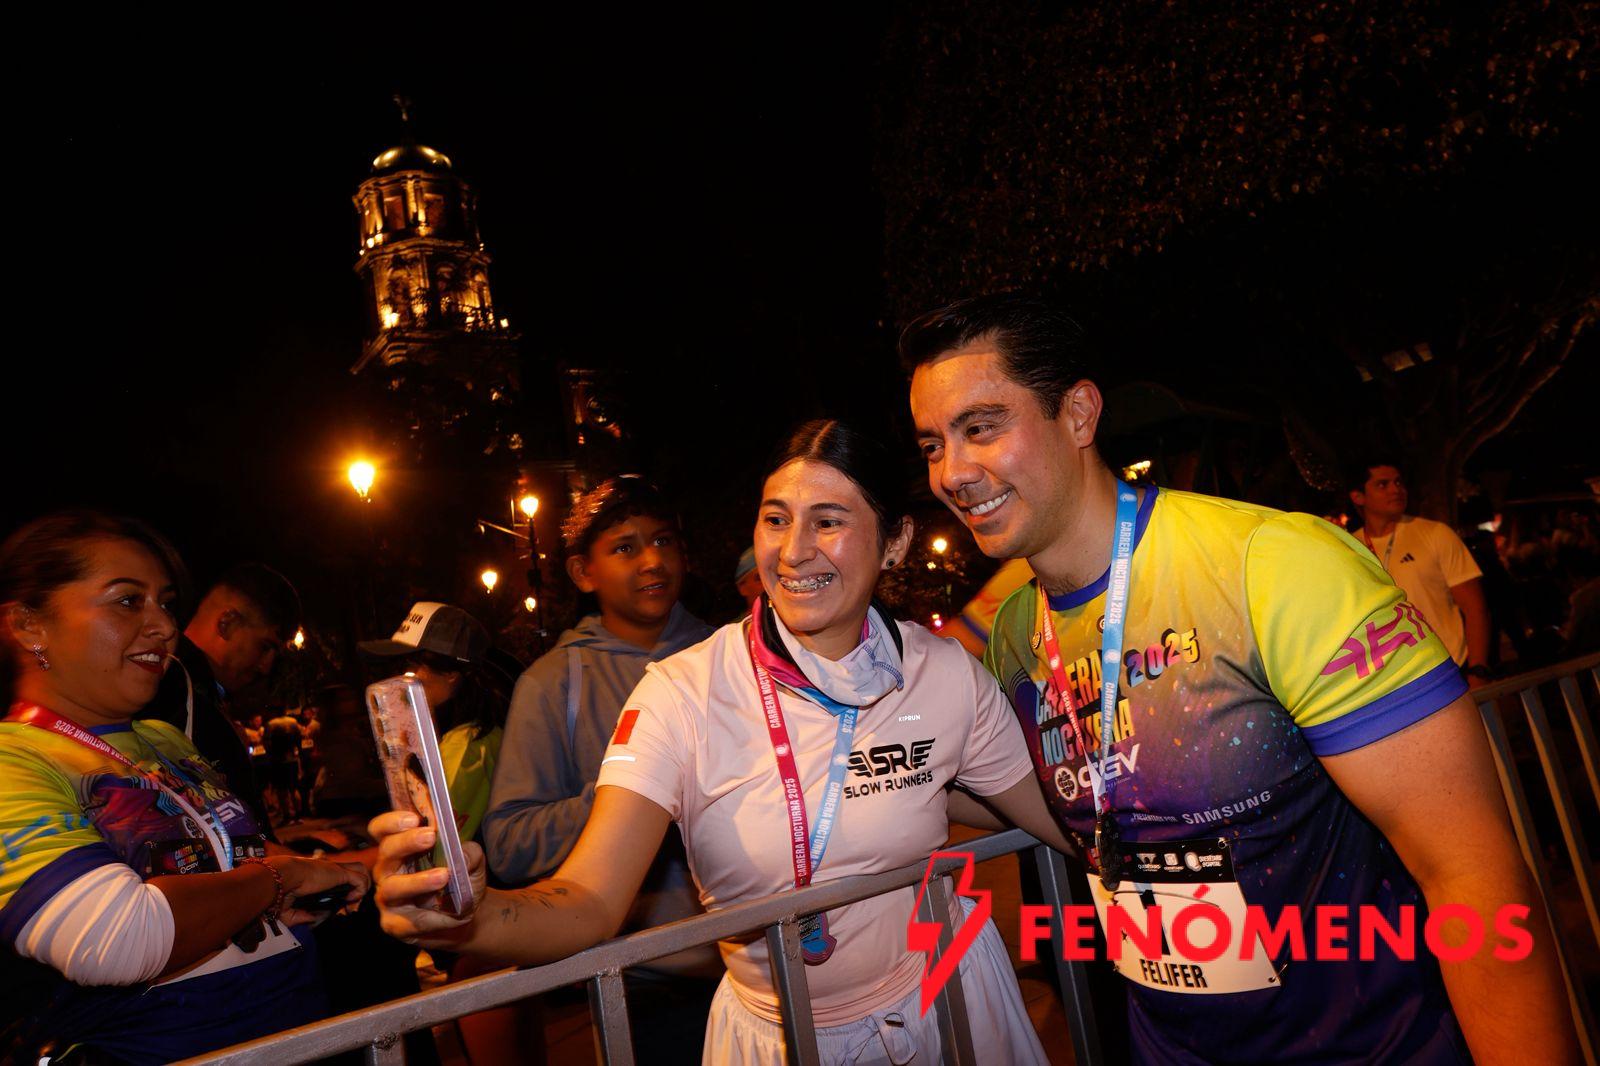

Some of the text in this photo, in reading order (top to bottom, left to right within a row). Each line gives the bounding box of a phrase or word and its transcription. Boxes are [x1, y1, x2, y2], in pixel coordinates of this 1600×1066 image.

[1109, 521, 1132, 624] CARRERA NOCTURNA 2025
[1124, 628, 1200, 688] 2025
[763, 694, 781, 729] CARRERA
[1104, 682, 1116, 722] CARRERA
[54, 719, 74, 736] 2025
[73, 728, 111, 753] NOCTURNA
[843, 770, 934, 799] SLOW RUNNERS
[811, 782, 840, 859] CARRERA NOCTURNA
[1182, 790, 1273, 825] SAMSUNG
[785, 778, 807, 877] CARRERA NOCTURNA 2025
[1139, 958, 1208, 988] FELIFER
